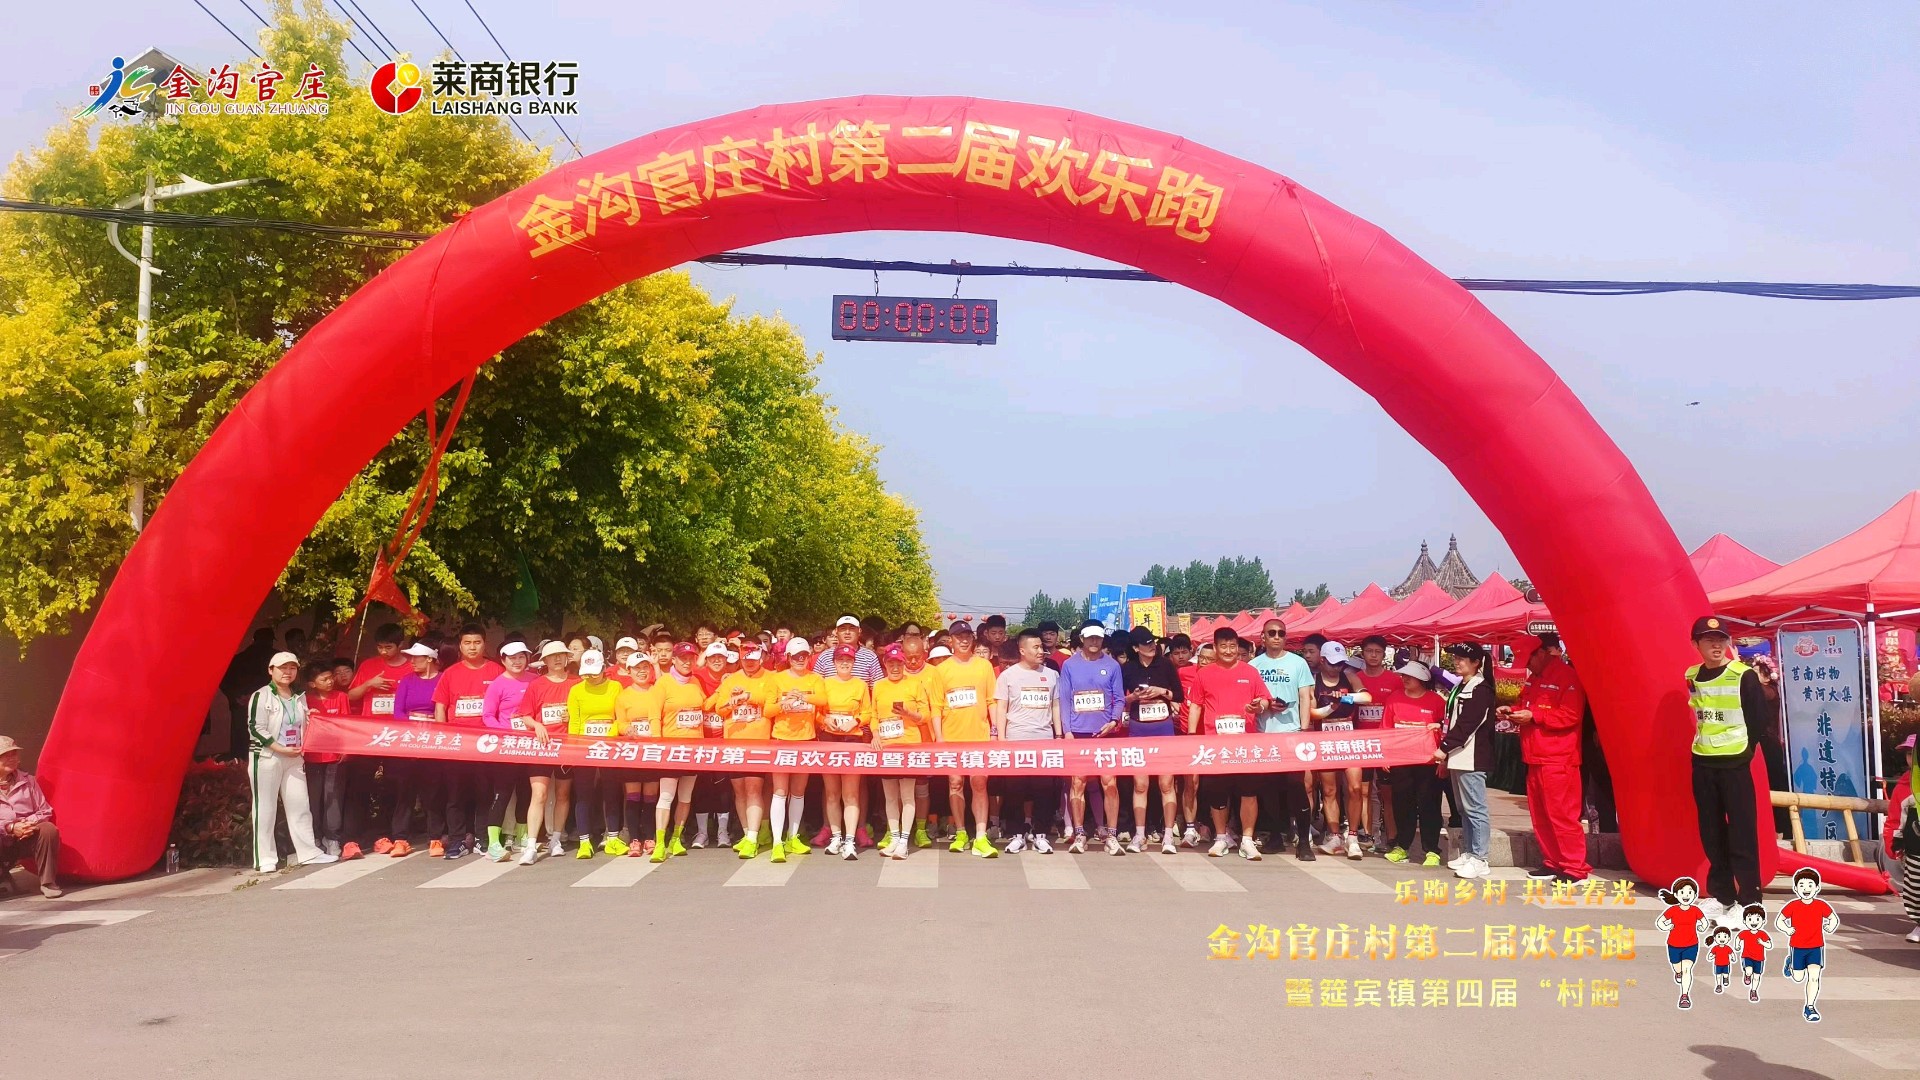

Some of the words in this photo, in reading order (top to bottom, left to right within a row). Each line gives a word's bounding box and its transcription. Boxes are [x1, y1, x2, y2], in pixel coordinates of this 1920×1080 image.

[517, 119, 1226, 258] 金沟官庄村第二届欢乐跑
[839, 299, 990, 335] 00:00:00
[1791, 665, 1841, 681] 莒南好物
[949, 692, 975, 703] A1018
[1022, 694, 1048, 702] A1046
[1075, 697, 1102, 705] A1033
[1802, 685, 1853, 702] 黄河大集
[456, 702, 483, 710] A1062
[400, 730, 463, 746] 金沟官庄
[538, 750, 560, 758] BANK
[1218, 745, 1281, 759] 金沟官庄
[1319, 739, 1382, 755] 莱商银行
[1322, 753, 1361, 761] LAISHANG
[1817, 711, 1837, 840] 非遗特区
